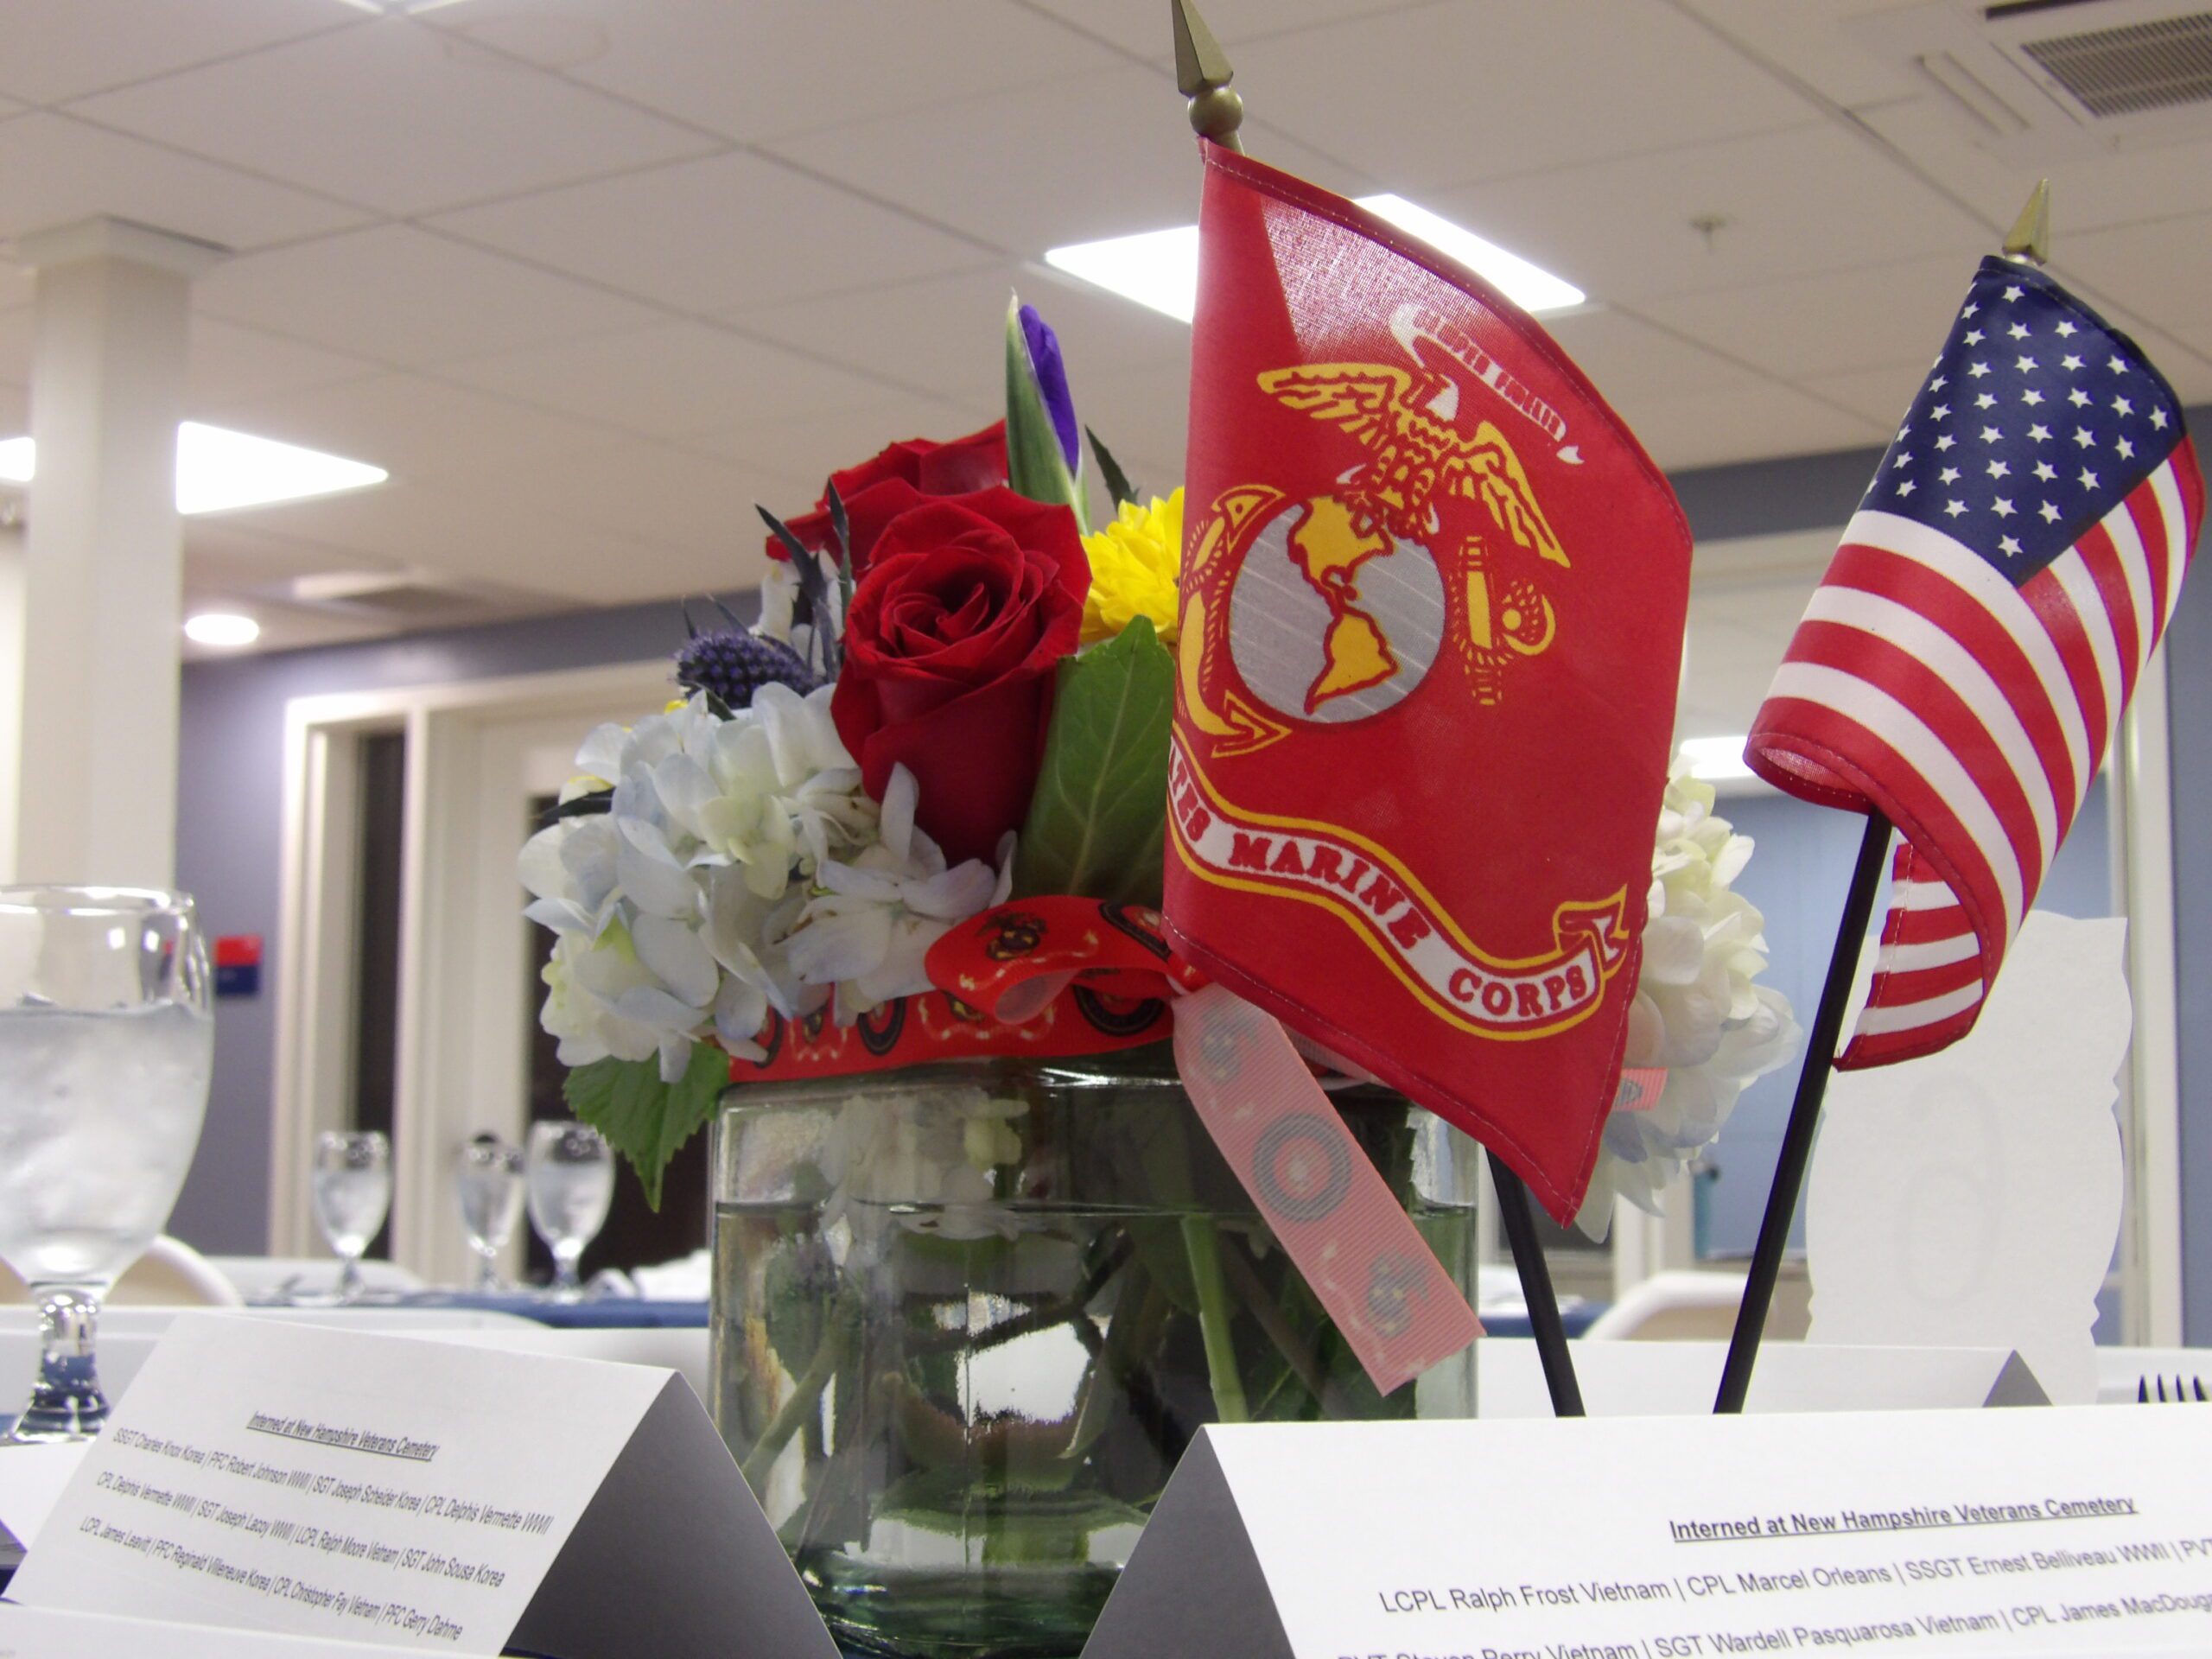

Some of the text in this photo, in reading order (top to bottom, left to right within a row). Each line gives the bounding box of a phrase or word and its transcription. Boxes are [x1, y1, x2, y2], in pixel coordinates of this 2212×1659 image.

[1228, 831, 1433, 950] MARINE
[1448, 963, 1586, 1019] CORPS
[249, 1411, 440, 1459] Interned at New Hampshire Veterans Cemetery
[1669, 1497, 2135, 1540] Interned at New Hampshire Veterans Cemetery
[1378, 1589, 1447, 1613] LCPL
[1449, 1586, 1517, 1612] Ralph
[1519, 1584, 1580, 1606] Frost
[1579, 1581, 1671, 1602] Vietnam
[1687, 1574, 1737, 1597] CPL
[1736, 1570, 1810, 1592] Marcel
[1812, 1567, 1892, 1587] Orleans
[1904, 1557, 1963, 1580] SSGT
[1967, 1554, 2032, 1575] Ernest
[2031, 1551, 2118, 1570] Belliveau
[2116, 1542, 2170, 1562] WWII
[1545, 1644, 1639, 1659] Vietnam
[1654, 1635, 1703, 1659] SGT
[1707, 1629, 1791, 1654] Wardell
[1792, 1622, 1916, 1647] Pasquarosa
[1916, 1614, 1999, 1635] Vietnam
[2012, 1605, 2057, 1626] CPL
[2061, 1603, 2120, 1622] James
